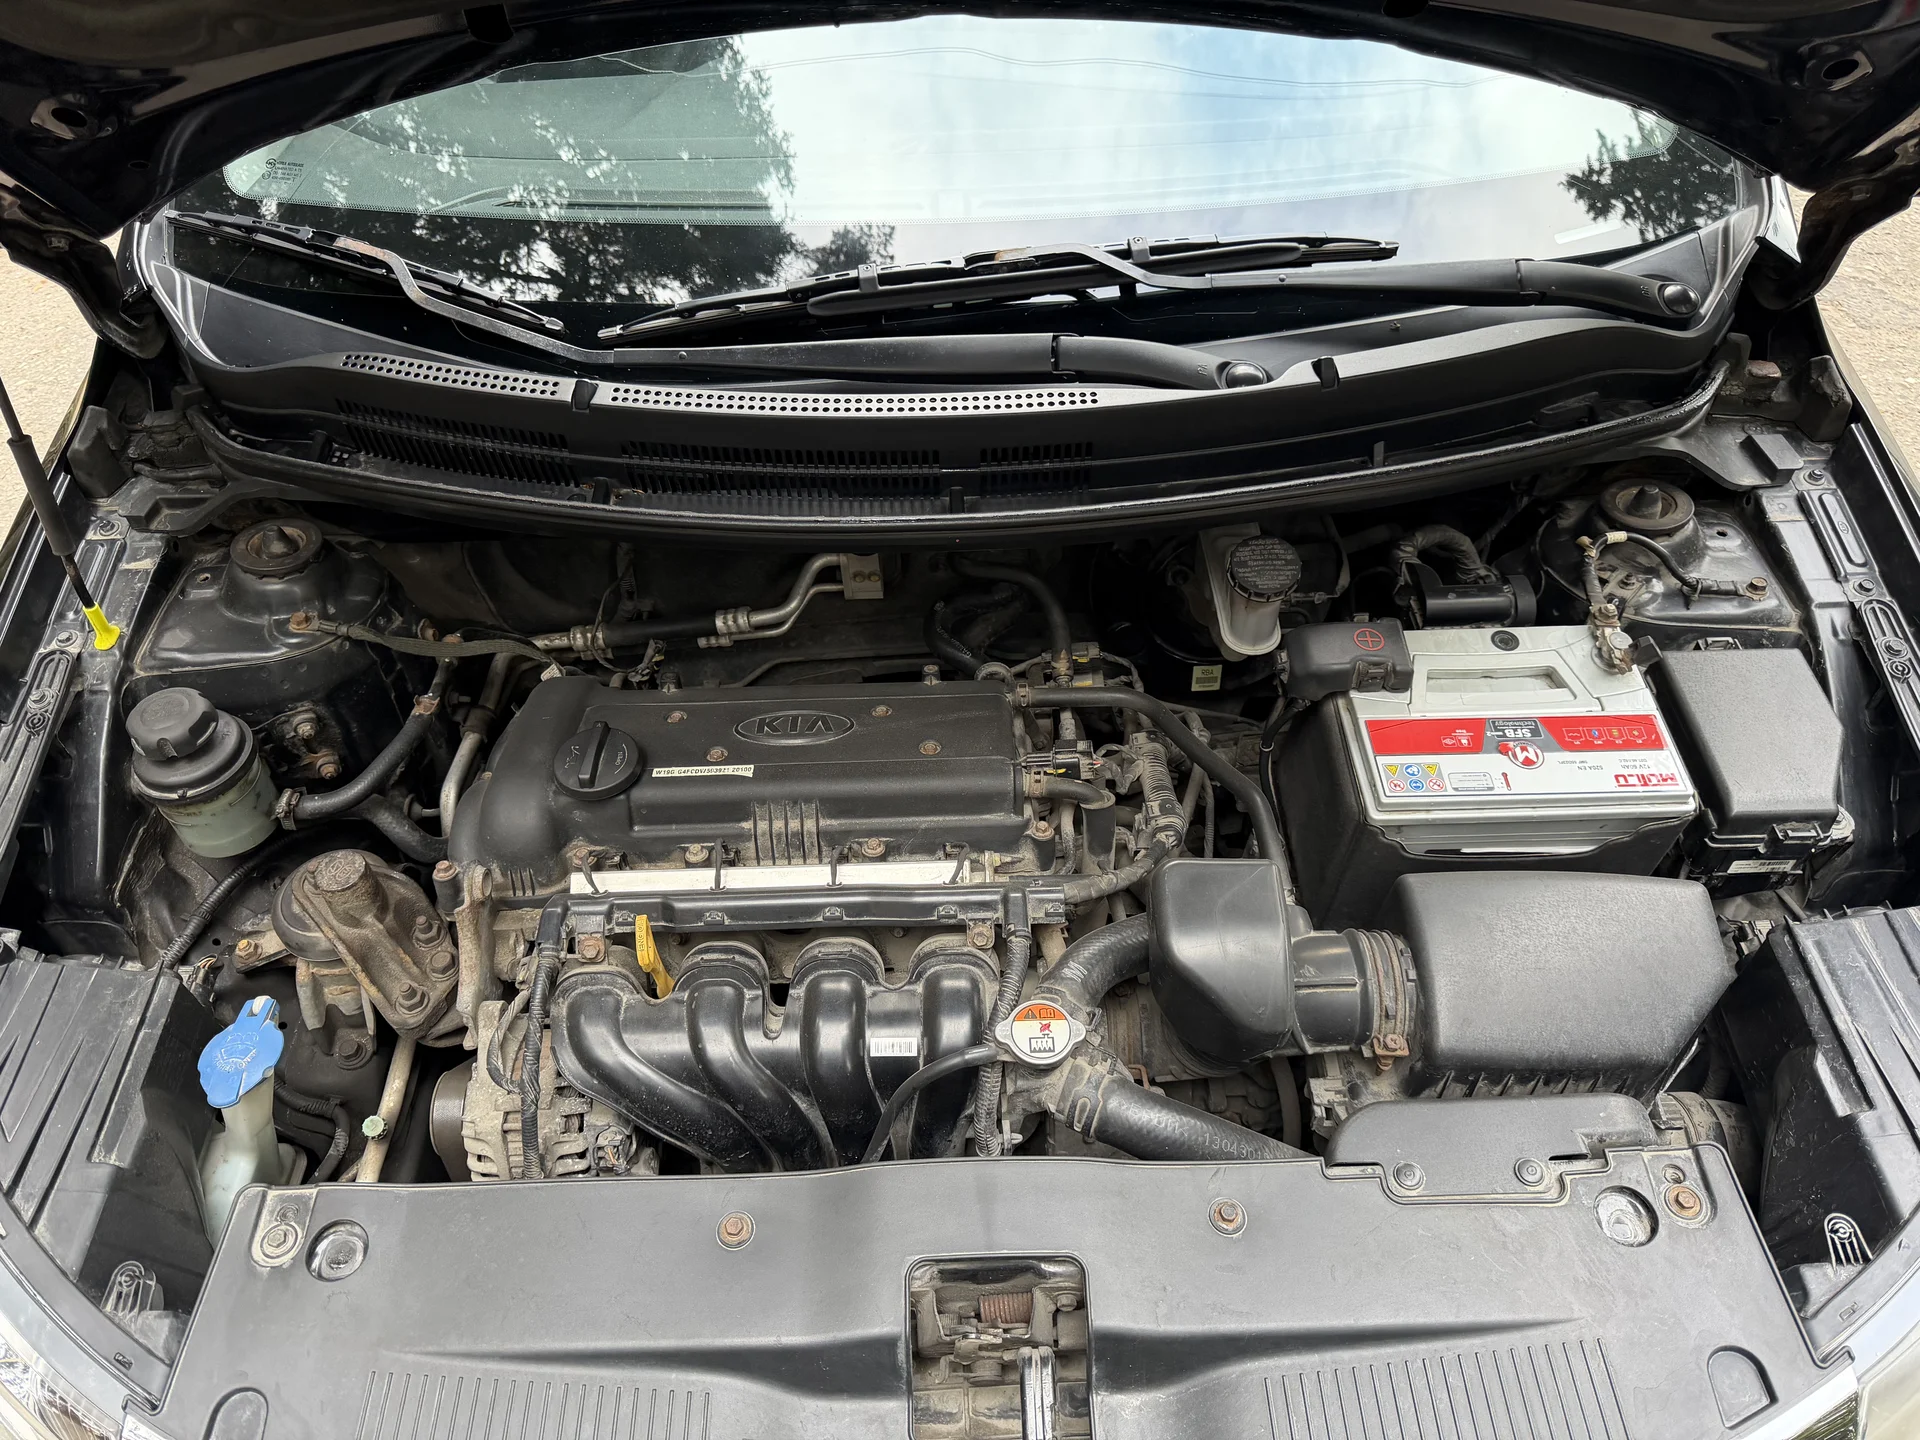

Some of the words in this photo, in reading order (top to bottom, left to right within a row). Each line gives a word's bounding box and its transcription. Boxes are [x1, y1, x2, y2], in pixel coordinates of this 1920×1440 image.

[754, 714, 835, 736] KIA
[1504, 728, 1532, 738] SFB
[1613, 773, 1680, 788] MUTLU
